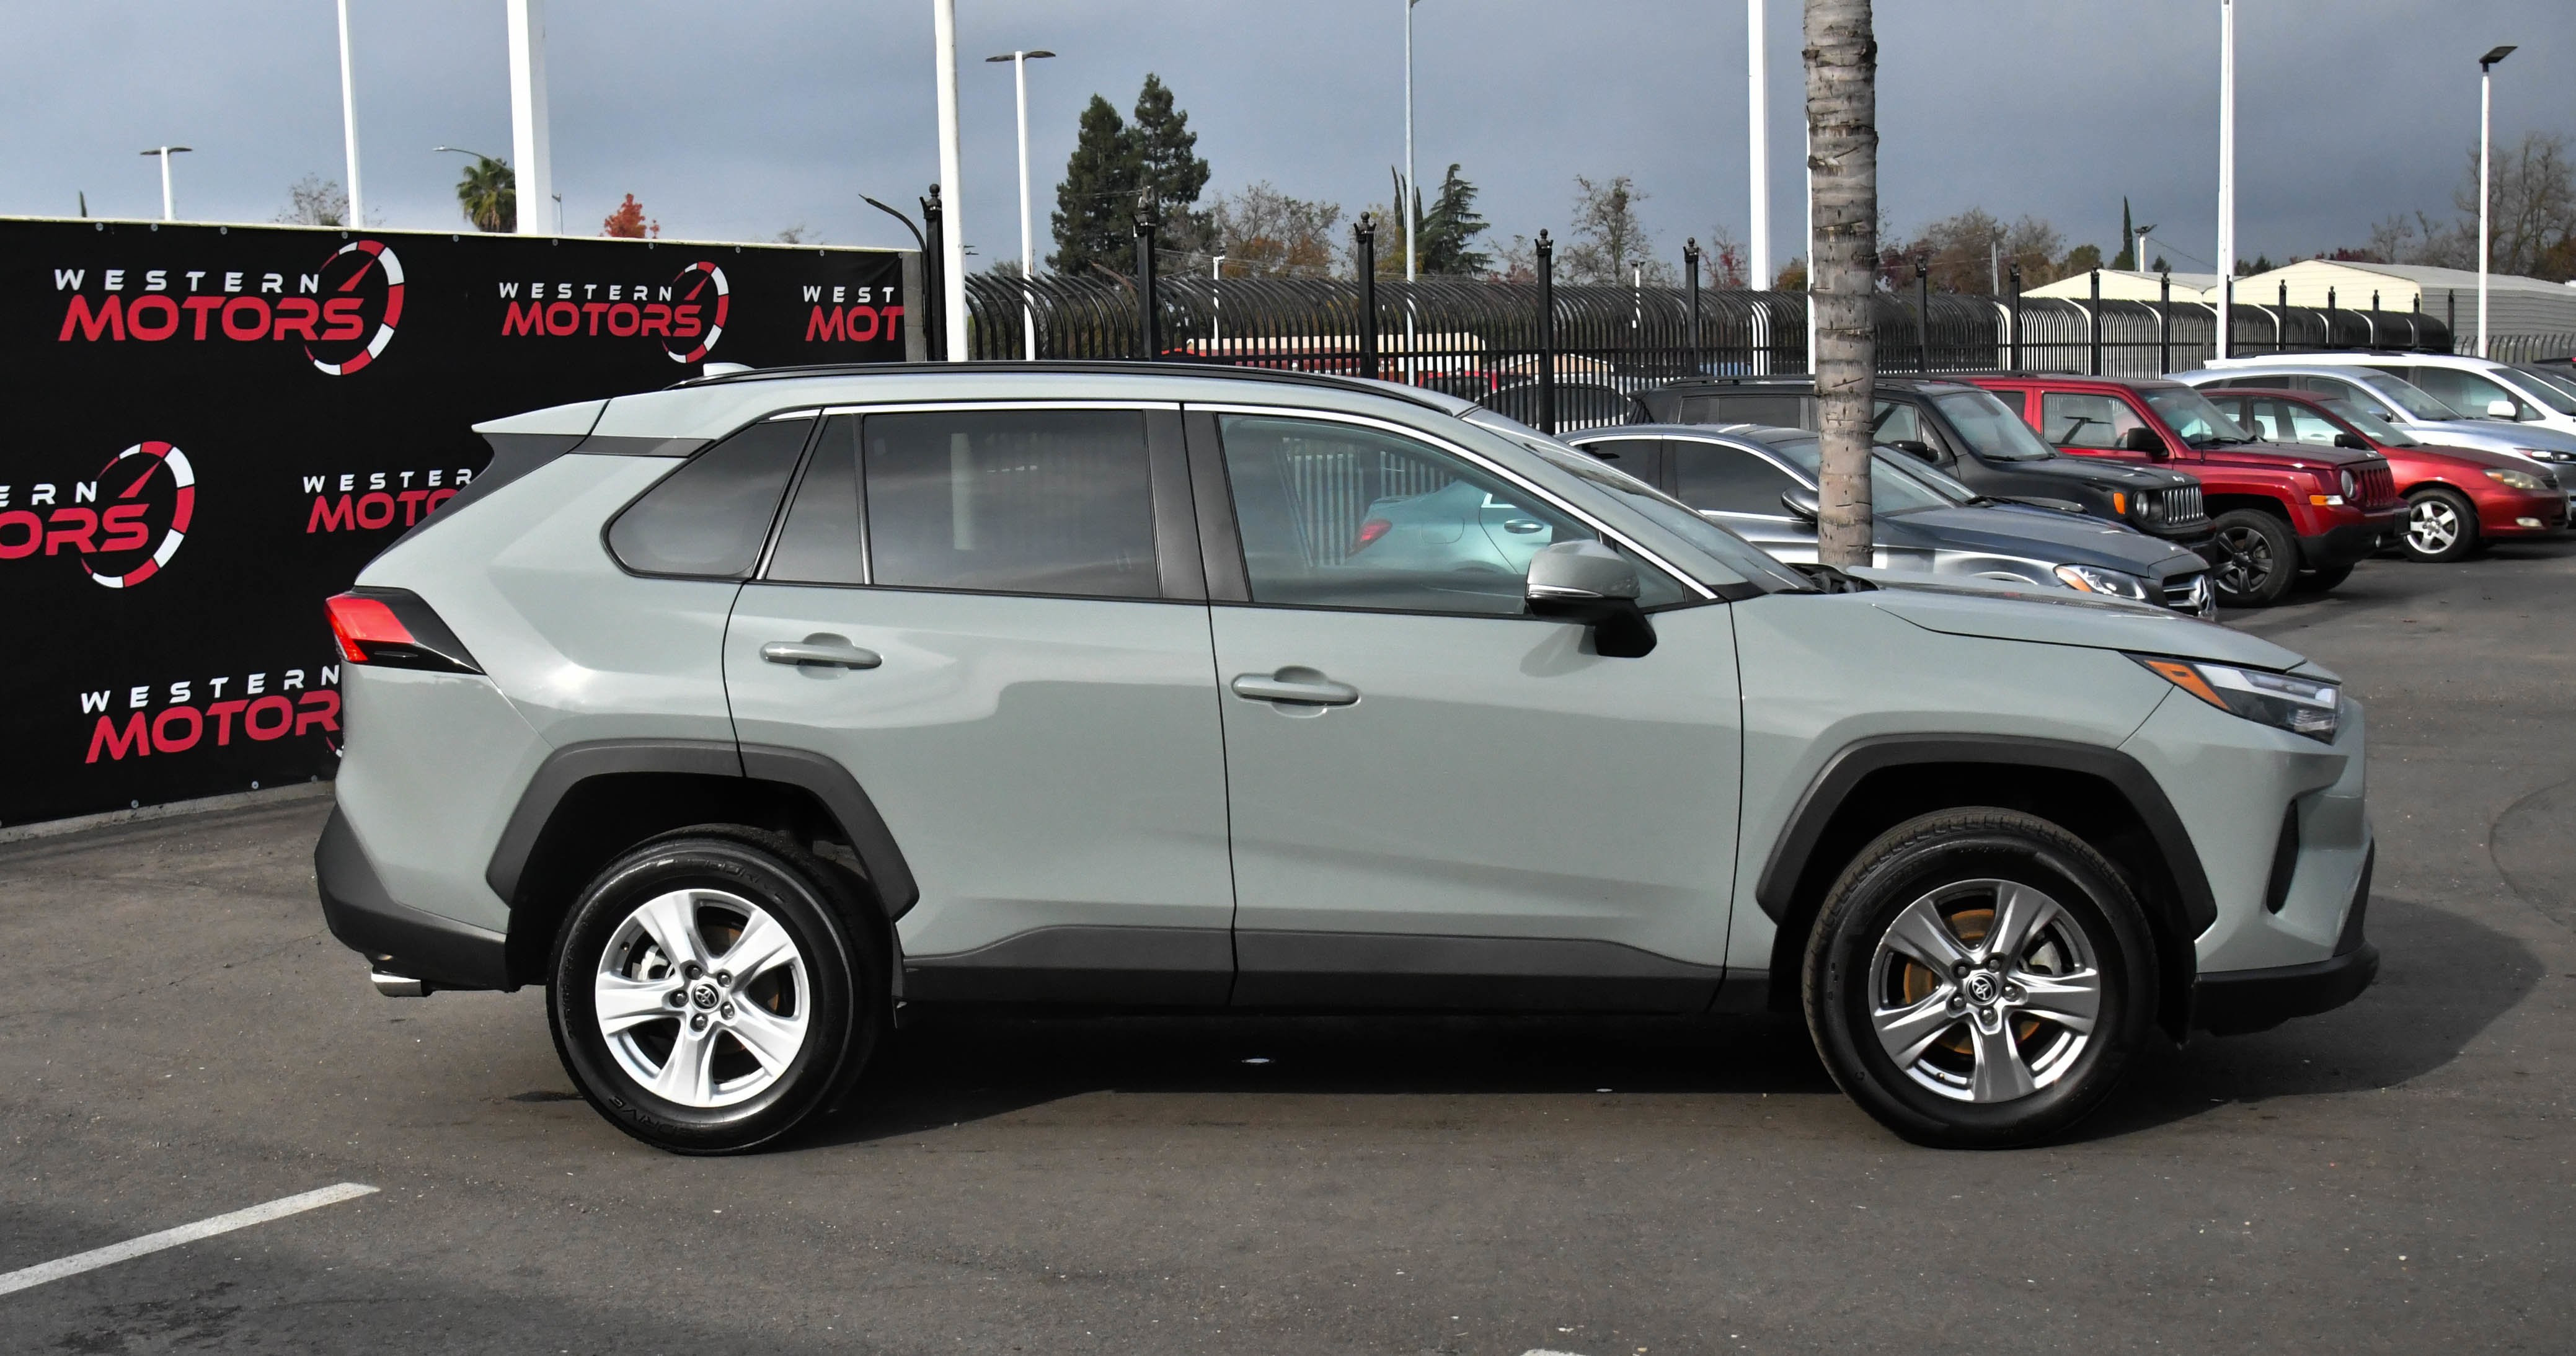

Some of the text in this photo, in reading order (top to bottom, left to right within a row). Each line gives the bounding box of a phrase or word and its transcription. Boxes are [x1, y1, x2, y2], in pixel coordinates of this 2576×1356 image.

[55, 269, 319, 294] WESTERN
[499, 282, 672, 301] WESTERN
[803, 285, 895, 303] WEST
[59, 294, 365, 342] MOTORS
[502, 301, 702, 337] MOTORS
[805, 305, 905, 342] MOT
[303, 469, 472, 494] WESTER
[0, 503, 149, 559] ORS
[81, 664, 340, 714] WESTERN
[85, 689, 340, 764] MOTOR
